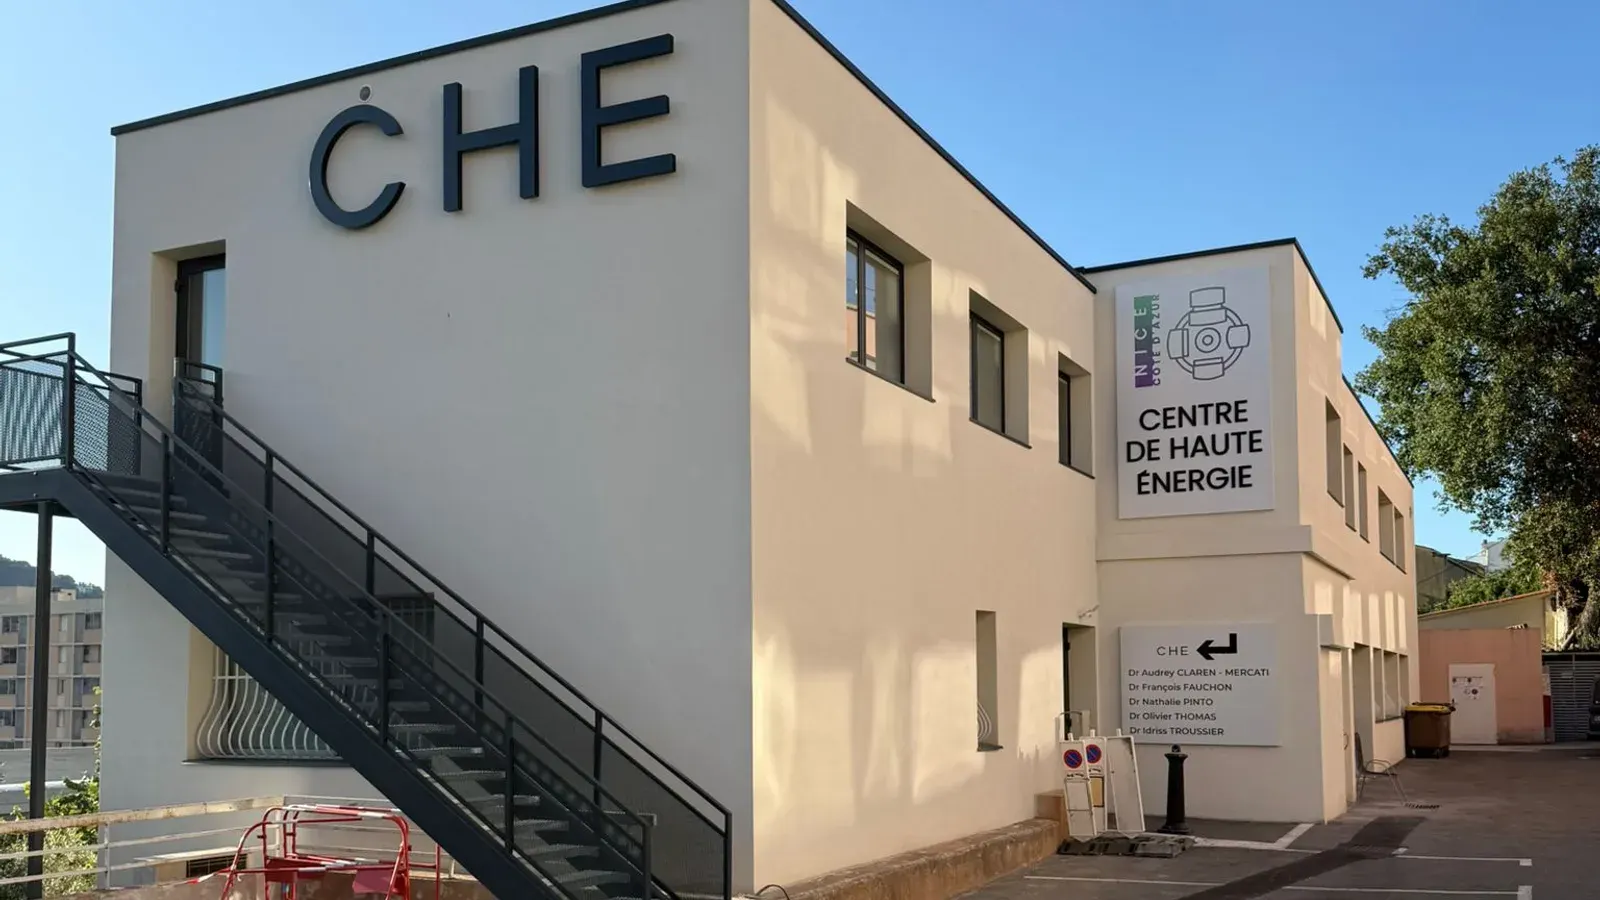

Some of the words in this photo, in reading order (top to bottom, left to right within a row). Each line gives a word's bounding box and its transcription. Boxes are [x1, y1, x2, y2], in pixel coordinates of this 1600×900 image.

[309, 33, 676, 229] CHE
[1134, 307, 1148, 376] NICE
[1139, 399, 1248, 431] CENTRE
[1126, 438, 1160, 463] DE
[1170, 430, 1263, 460] HAUTE
[1137, 465, 1253, 495] ÉNERGIE
[1156, 646, 1189, 656] CHE
[1129, 669, 1139, 677] Dr
[1142, 669, 1175, 678] Audrey
[1177, 669, 1216, 677] CLAREN
[1129, 683, 1139, 691] Dr
[1142, 683, 1181, 693] François
[1183, 698, 1213, 706] PINTO
[1129, 712, 1140, 720] Dr
[1142, 712, 1172, 720] Olivier
[1175, 713, 1216, 721] THOMAS
[1143, 727, 1167, 735] Idriss
[1170, 727, 1224, 735] TROUSSIER
